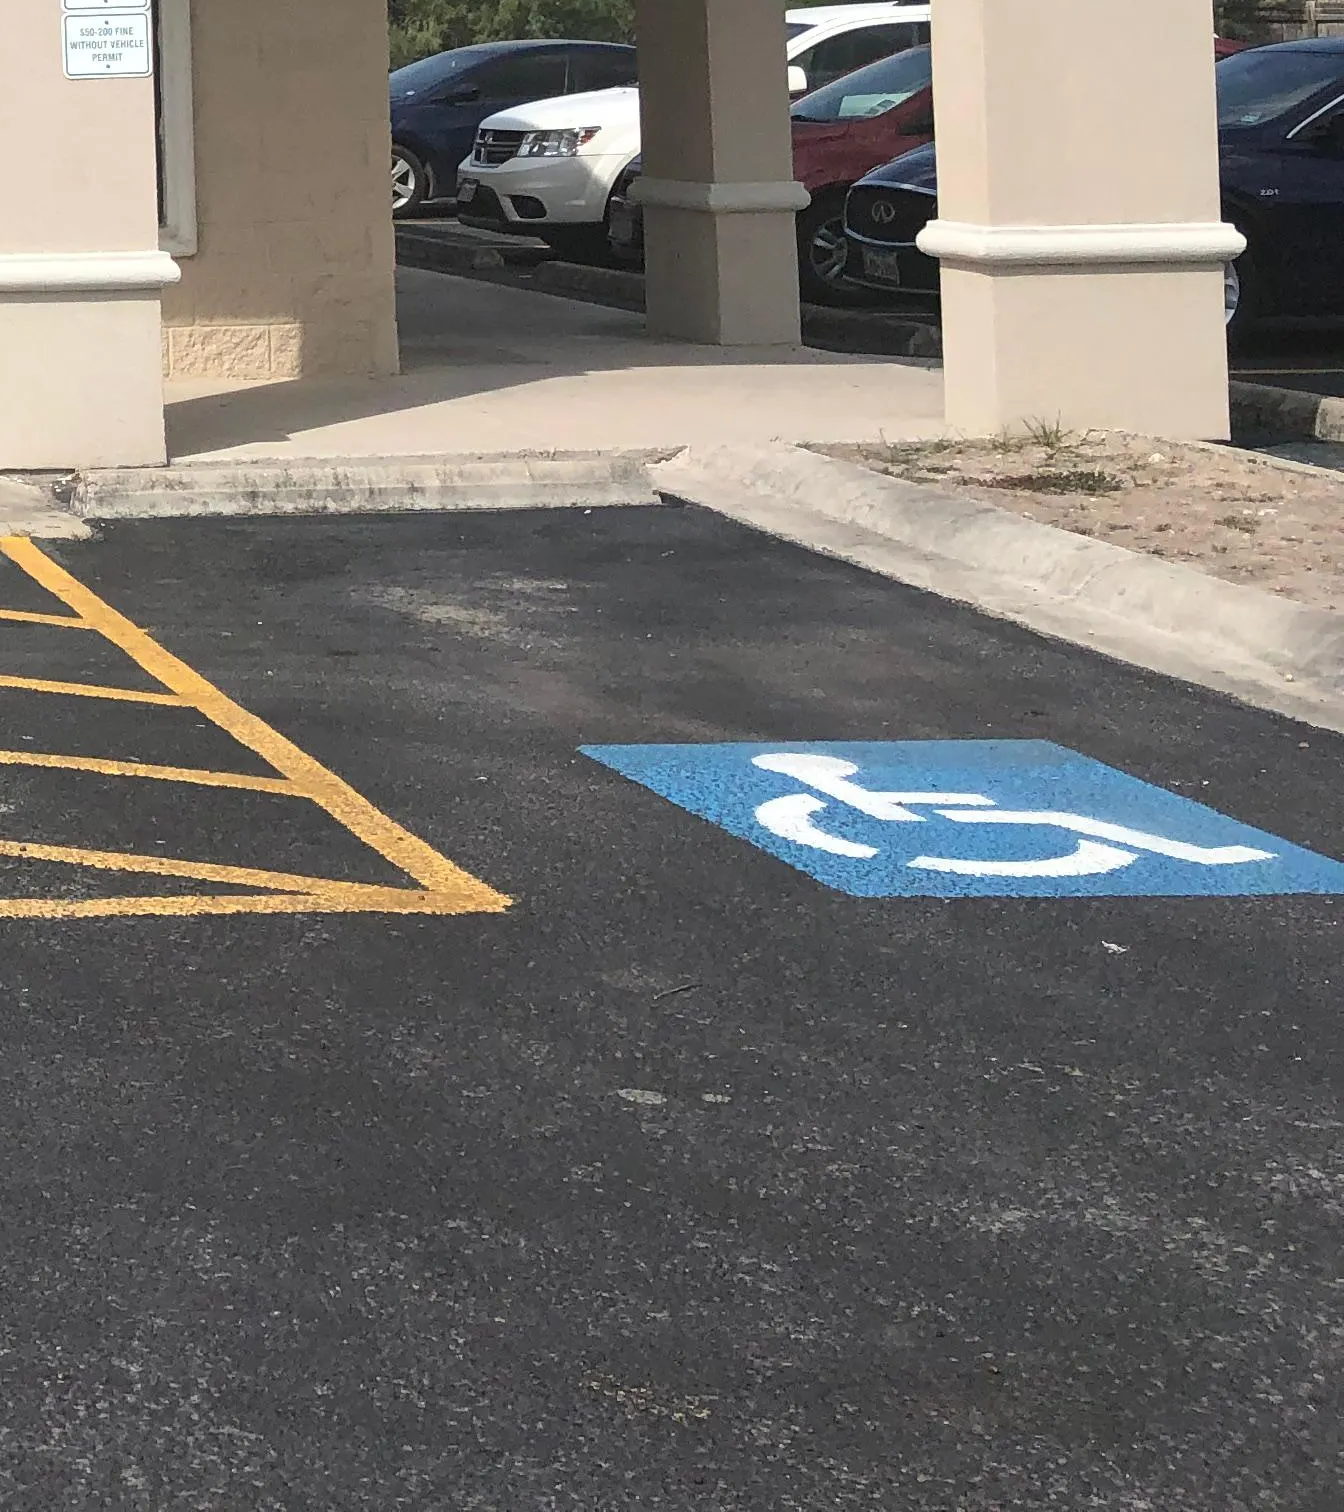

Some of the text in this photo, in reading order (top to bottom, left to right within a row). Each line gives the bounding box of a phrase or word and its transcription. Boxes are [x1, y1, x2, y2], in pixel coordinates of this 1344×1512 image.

[79, 26, 134, 37] $50-200 FINE
[70, 39, 144, 50] WITHOUT VEHICLE
[92, 52, 123, 62] PERMIT
